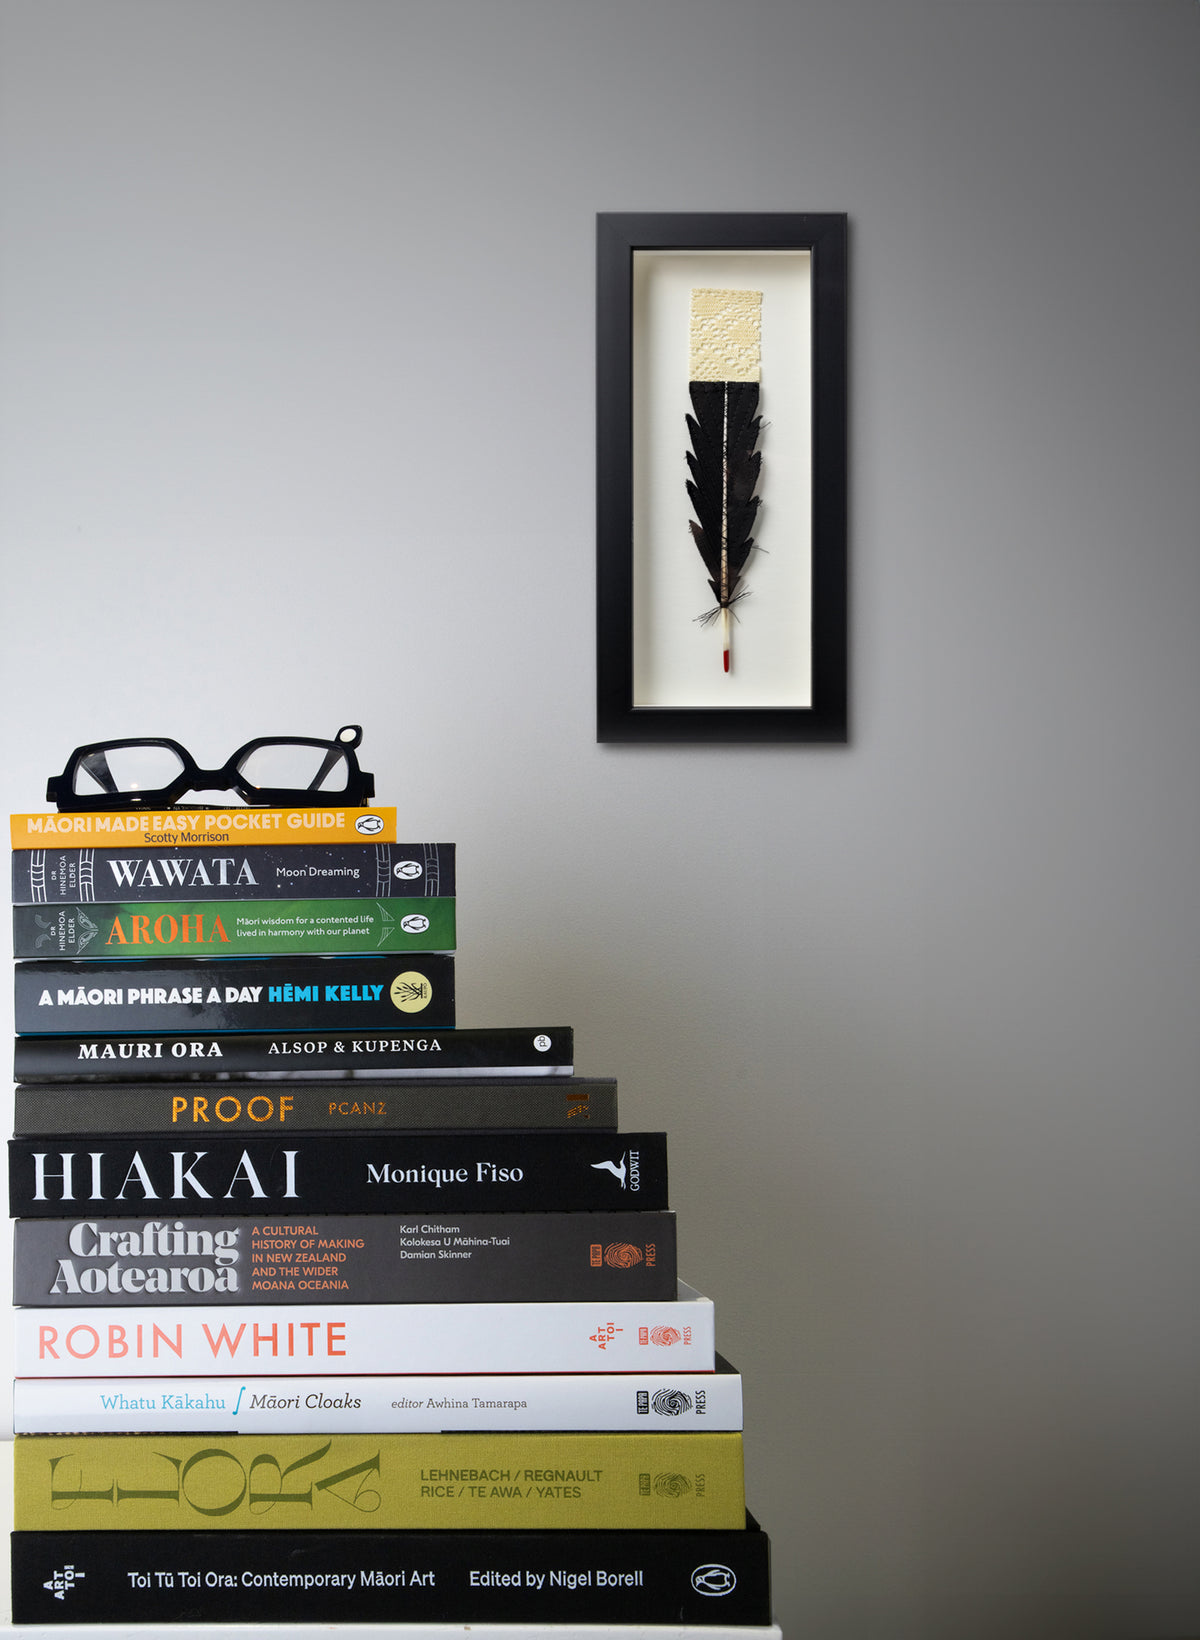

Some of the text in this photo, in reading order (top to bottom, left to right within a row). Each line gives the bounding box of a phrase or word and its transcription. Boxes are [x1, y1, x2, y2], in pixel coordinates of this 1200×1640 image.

[26, 813, 345, 833] MĀORI MADE EASY POCKET GUIDE
[143, 830, 229, 844] Scotty Morrison
[50, 870, 57, 881] DR
[59, 856, 67, 895] HINEMOA
[68, 863, 77, 887] ELDER
[107, 859, 258, 887] WAWATA
[277, 865, 359, 878] Moon Dreaming
[104, 913, 231, 944] AROHA
[237, 917, 259, 926] Māori
[262, 916, 294, 926] wisdom
[296, 916, 308, 925] for
[316, 915, 358, 924] contented
[361, 914, 374, 924] life
[50, 926, 57, 936] DR
[58, 911, 66, 950] HINEMOA
[67, 918, 76, 943] ELDER
[237, 926, 369, 938] lived in harmony with our planet
[39, 987, 263, 1005] A MĀORI PHRASE A DAY
[269, 984, 384, 1002] HĒMI KELLY
[78, 1042, 223, 1059] MAURI ORA
[269, 1040, 441, 1054] ALSOP & KUPENGA
[173, 1096, 293, 1122] PROOF
[329, 1102, 386, 1115] PCANZ
[32, 1150, 298, 1200] HIAKAI
[367, 1163, 523, 1187] Monique Fiso
[629, 1150, 640, 1191] GODWIT
[251, 1225, 318, 1236] A CULTURAL
[400, 1224, 459, 1234] Karl Chitham
[69, 1222, 241, 1264] Crafting
[252, 1238, 364, 1250] HISTORY OF MAKING
[401, 1236, 509, 1247] Kolokesa U Māhina-Tuai
[252, 1252, 346, 1264] IN NEW ZEALAND
[401, 1249, 472, 1260] Damian Skinner
[645, 1244, 656, 1266] PRESS
[50, 1257, 240, 1295] Aotearoa
[252, 1266, 338, 1277] AND THE WIDER
[252, 1279, 349, 1291] MOANA OCEANIA
[40, 1323, 346, 1359] ROBIN WHITE
[597, 1327, 607, 1350] ART
[604, 1323, 615, 1341] TOI
[682, 1327, 692, 1345] PRESS
[101, 1393, 225, 1409] Whatu Kākahu
[250, 1393, 361, 1408] Māori Cloaks
[392, 1397, 527, 1410] editor Awhina Tamarapa
[695, 1391, 706, 1414] PRESS
[48, 1440, 382, 1517] FLORA
[421, 1469, 510, 1481] LEHNEBACH
[524, 1470, 603, 1482] REGNAULT
[421, 1486, 454, 1497] RICE
[469, 1486, 487, 1498] TE
[490, 1486, 522, 1498] AWA
[536, 1486, 581, 1498] YATES
[694, 1474, 706, 1497] PRESS
[52, 1571, 66, 1600] ART
[63, 1565, 76, 1591] TOI
[128, 1571, 435, 1589] Toi Tū Toi Ora: Contemporary Māori Art
[470, 1571, 643, 1589] Edited by Nigel Borell
